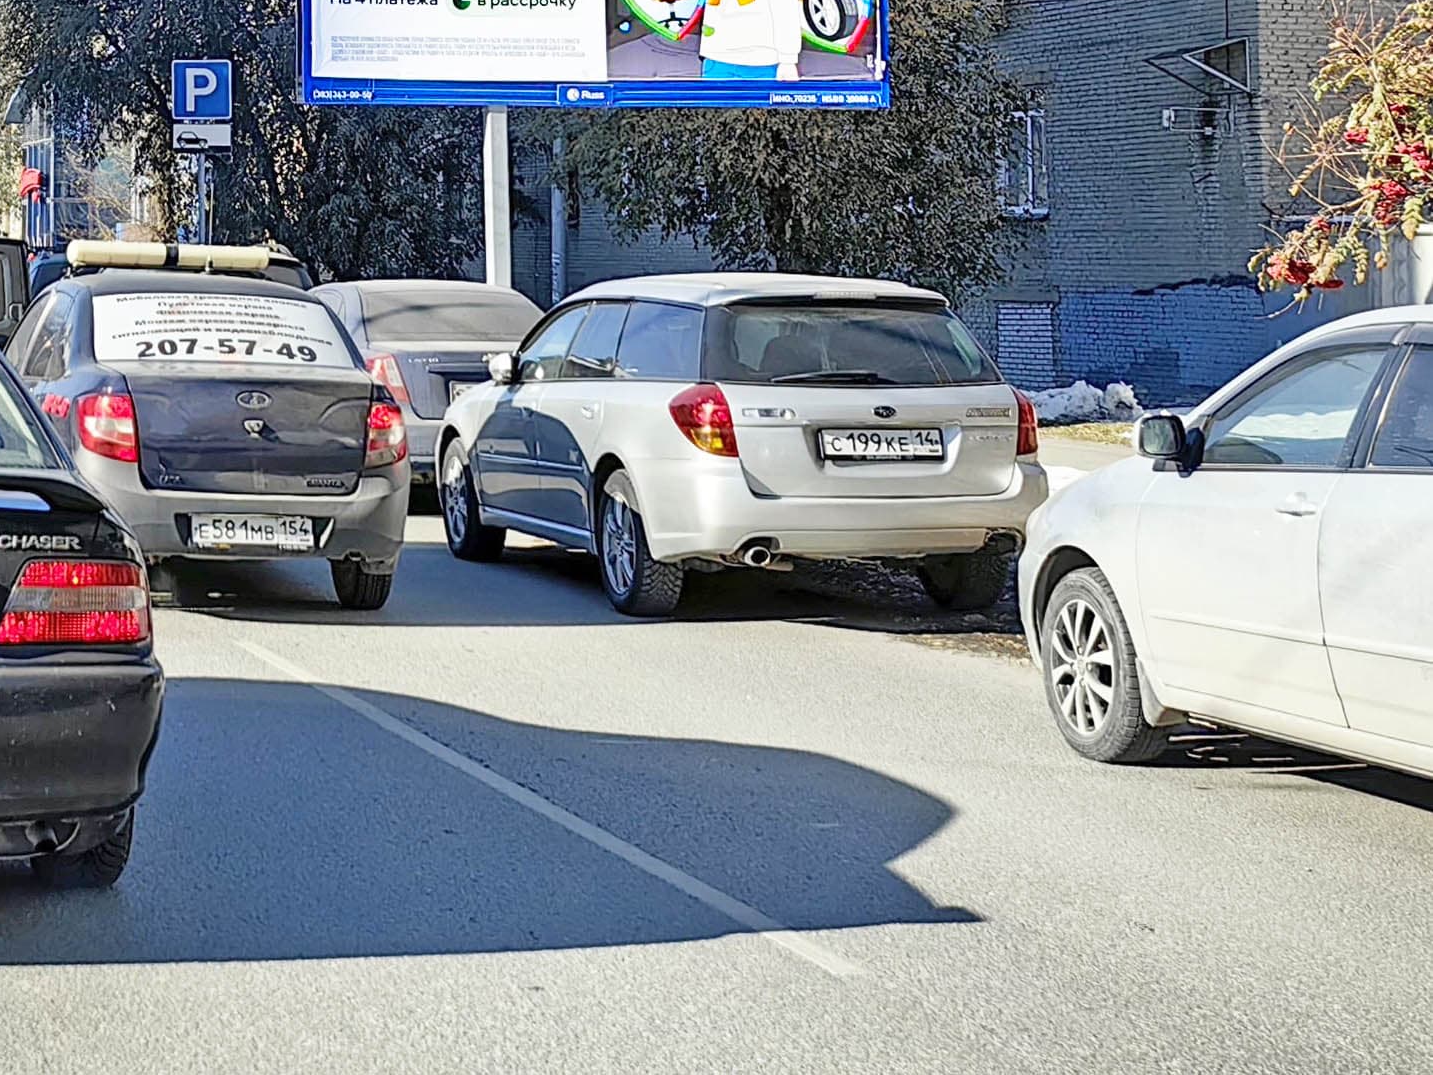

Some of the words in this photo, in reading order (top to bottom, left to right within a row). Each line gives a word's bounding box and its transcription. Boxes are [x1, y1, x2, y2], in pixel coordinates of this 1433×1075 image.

[186, 67, 218, 112] P
[135, 337, 318, 363] 207-57-49
[915, 431, 935, 446] 14
[279, 520, 310, 536] 154
